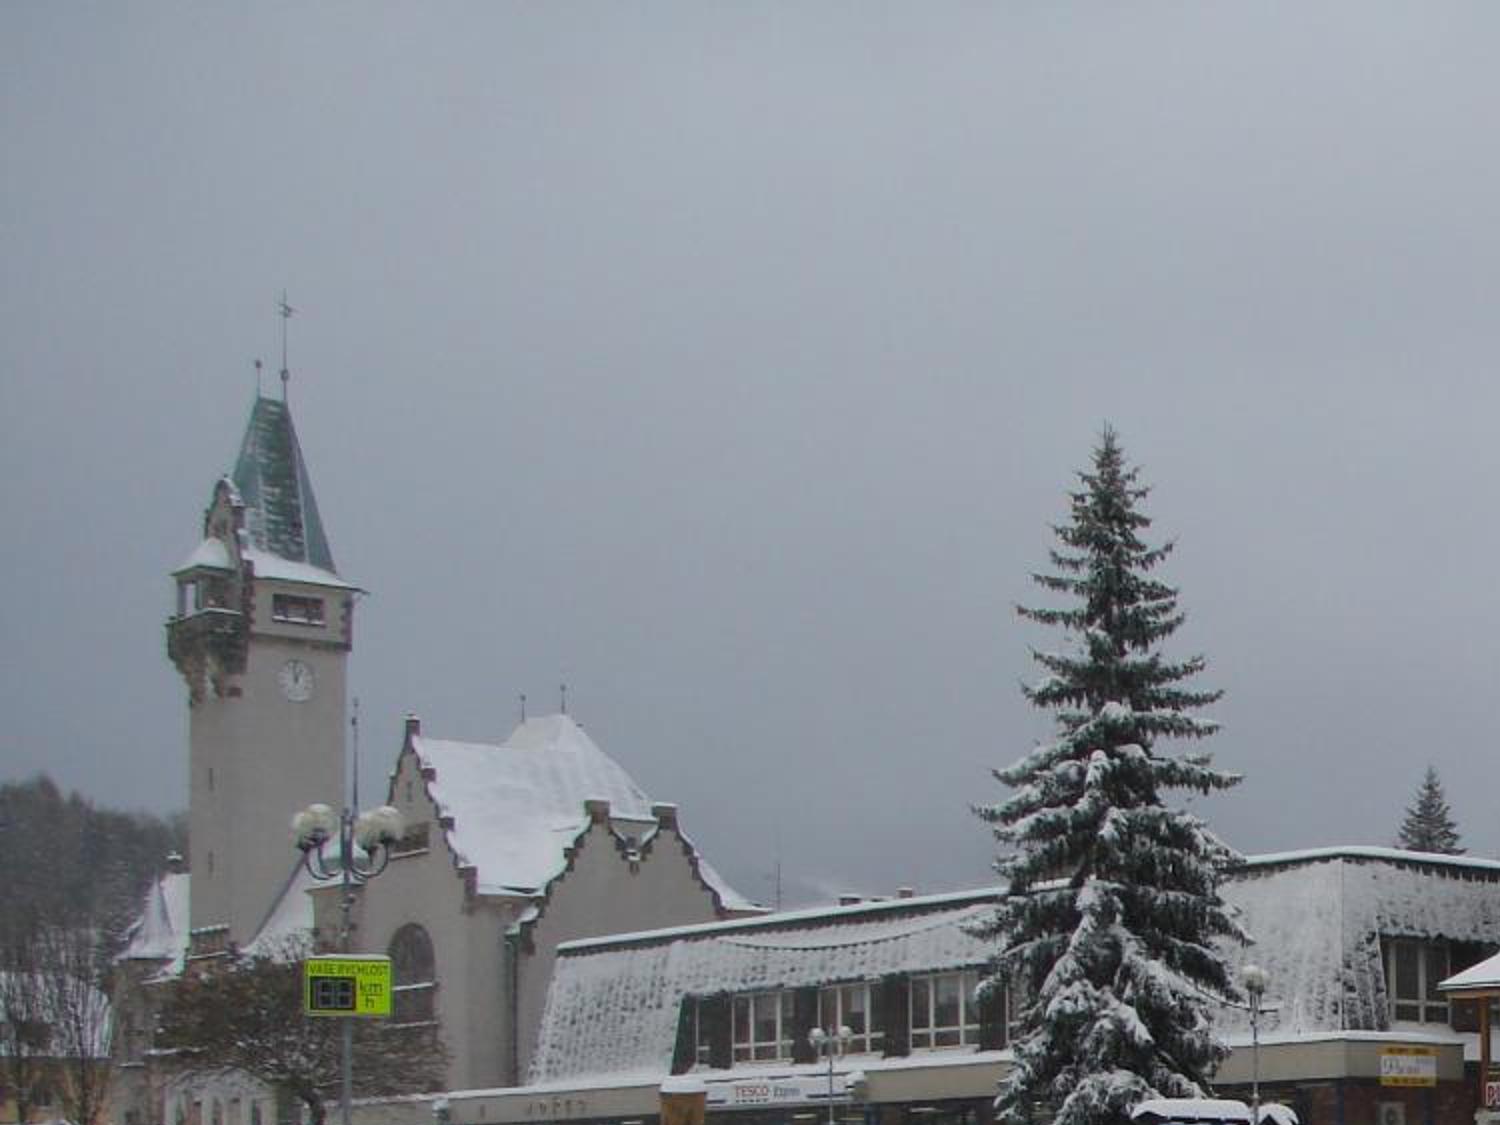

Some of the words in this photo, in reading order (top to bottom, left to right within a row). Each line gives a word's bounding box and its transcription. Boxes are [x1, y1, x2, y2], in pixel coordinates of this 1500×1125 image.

[360, 980, 383, 994] km
[365, 995, 375, 1009] h
[735, 1085, 769, 1097] TESCO
